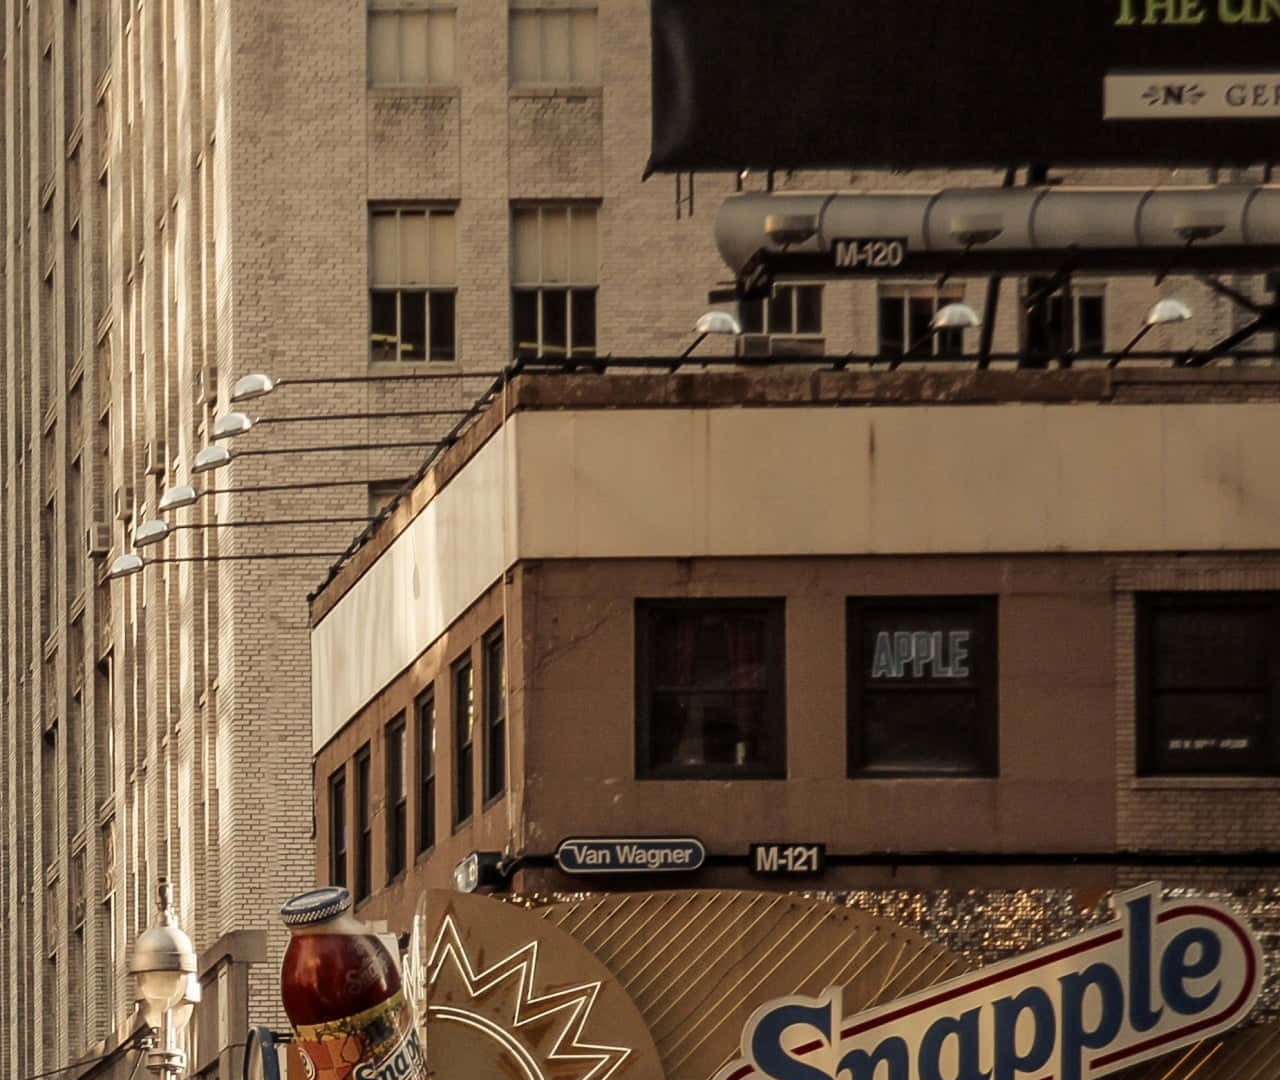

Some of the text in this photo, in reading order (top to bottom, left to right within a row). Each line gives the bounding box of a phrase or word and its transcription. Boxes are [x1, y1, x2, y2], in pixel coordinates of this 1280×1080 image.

[835, 240, 904, 268] M-120
[871, 630, 970, 679] APPLE
[574, 843, 693, 870] Van Wagner
[755, 846, 819, 872] M-121
